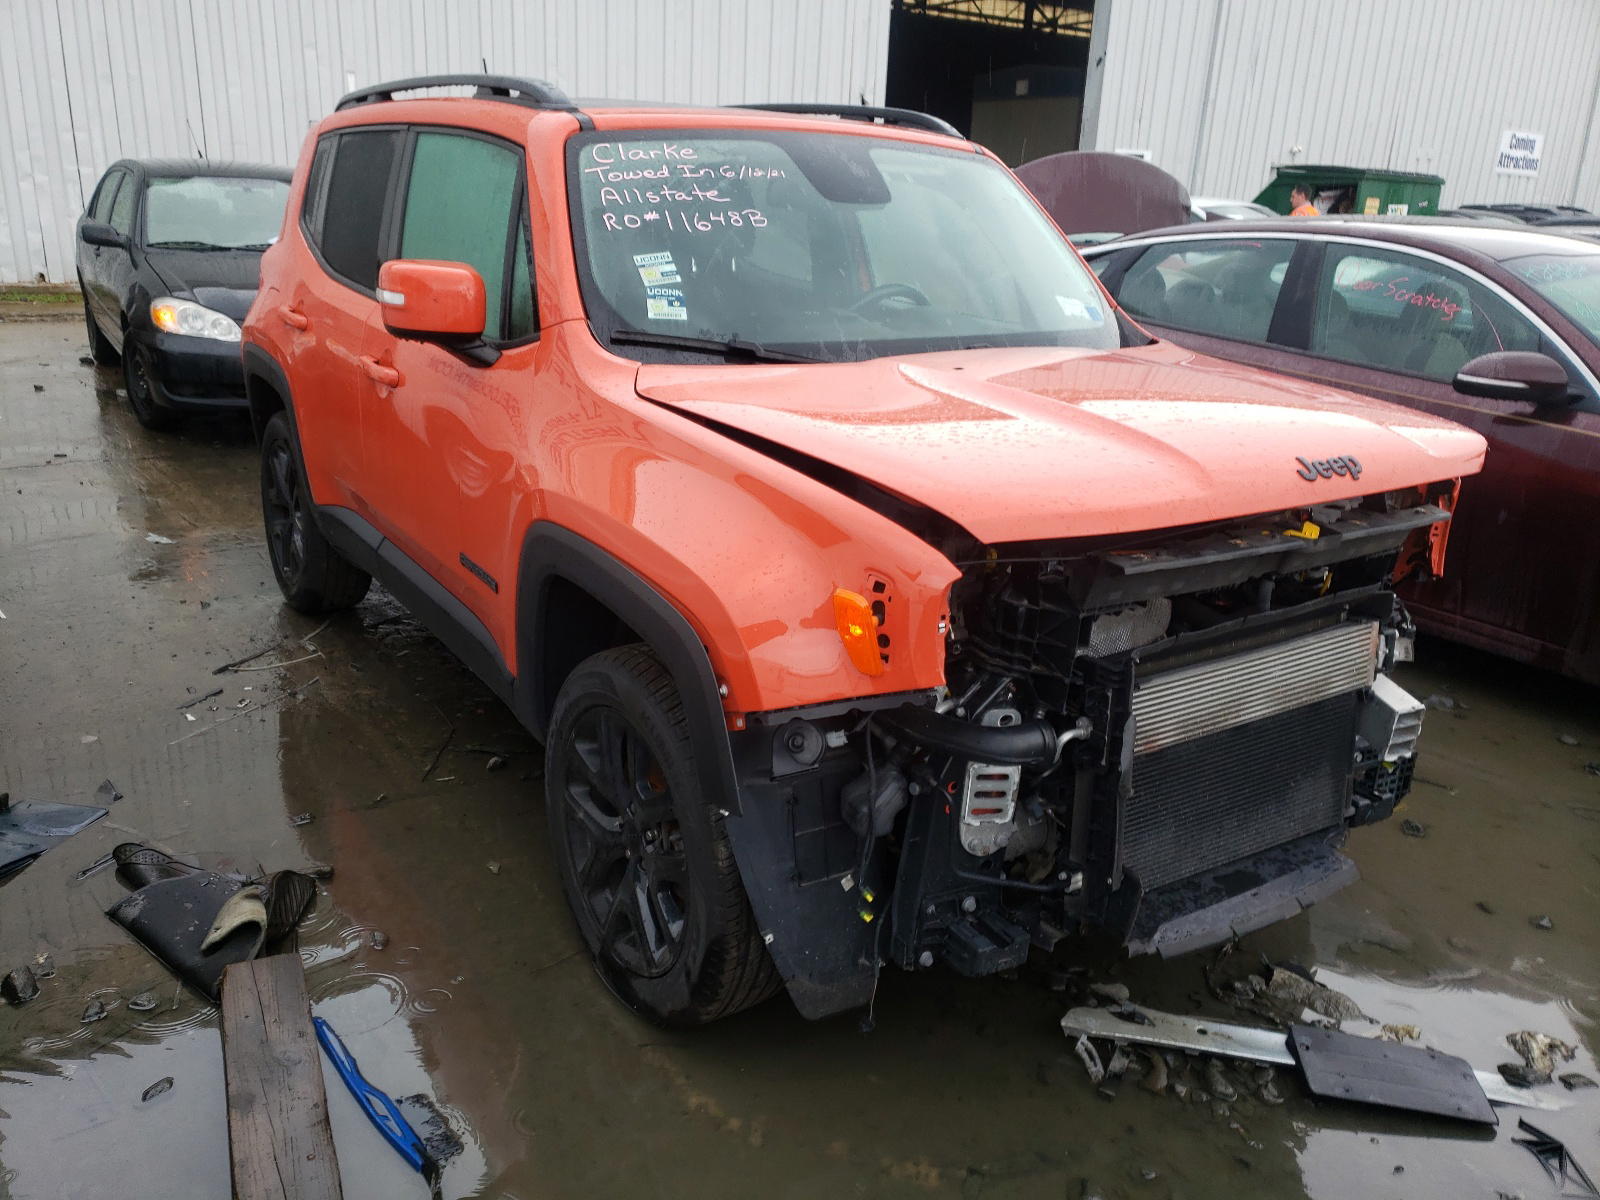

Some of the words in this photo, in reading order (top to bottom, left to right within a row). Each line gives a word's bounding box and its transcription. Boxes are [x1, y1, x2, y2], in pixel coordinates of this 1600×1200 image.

[592, 142, 698, 164] Clarke
[1509, 133, 1537, 154] Coming
[1497, 151, 1540, 171] Attractions
[584, 165, 671, 184] Towed
[677, 164, 715, 179] In
[600, 183, 732, 207] Allstate
[646, 287, 684, 297] UCONN
[1295, 455, 1363, 481] Jeep
